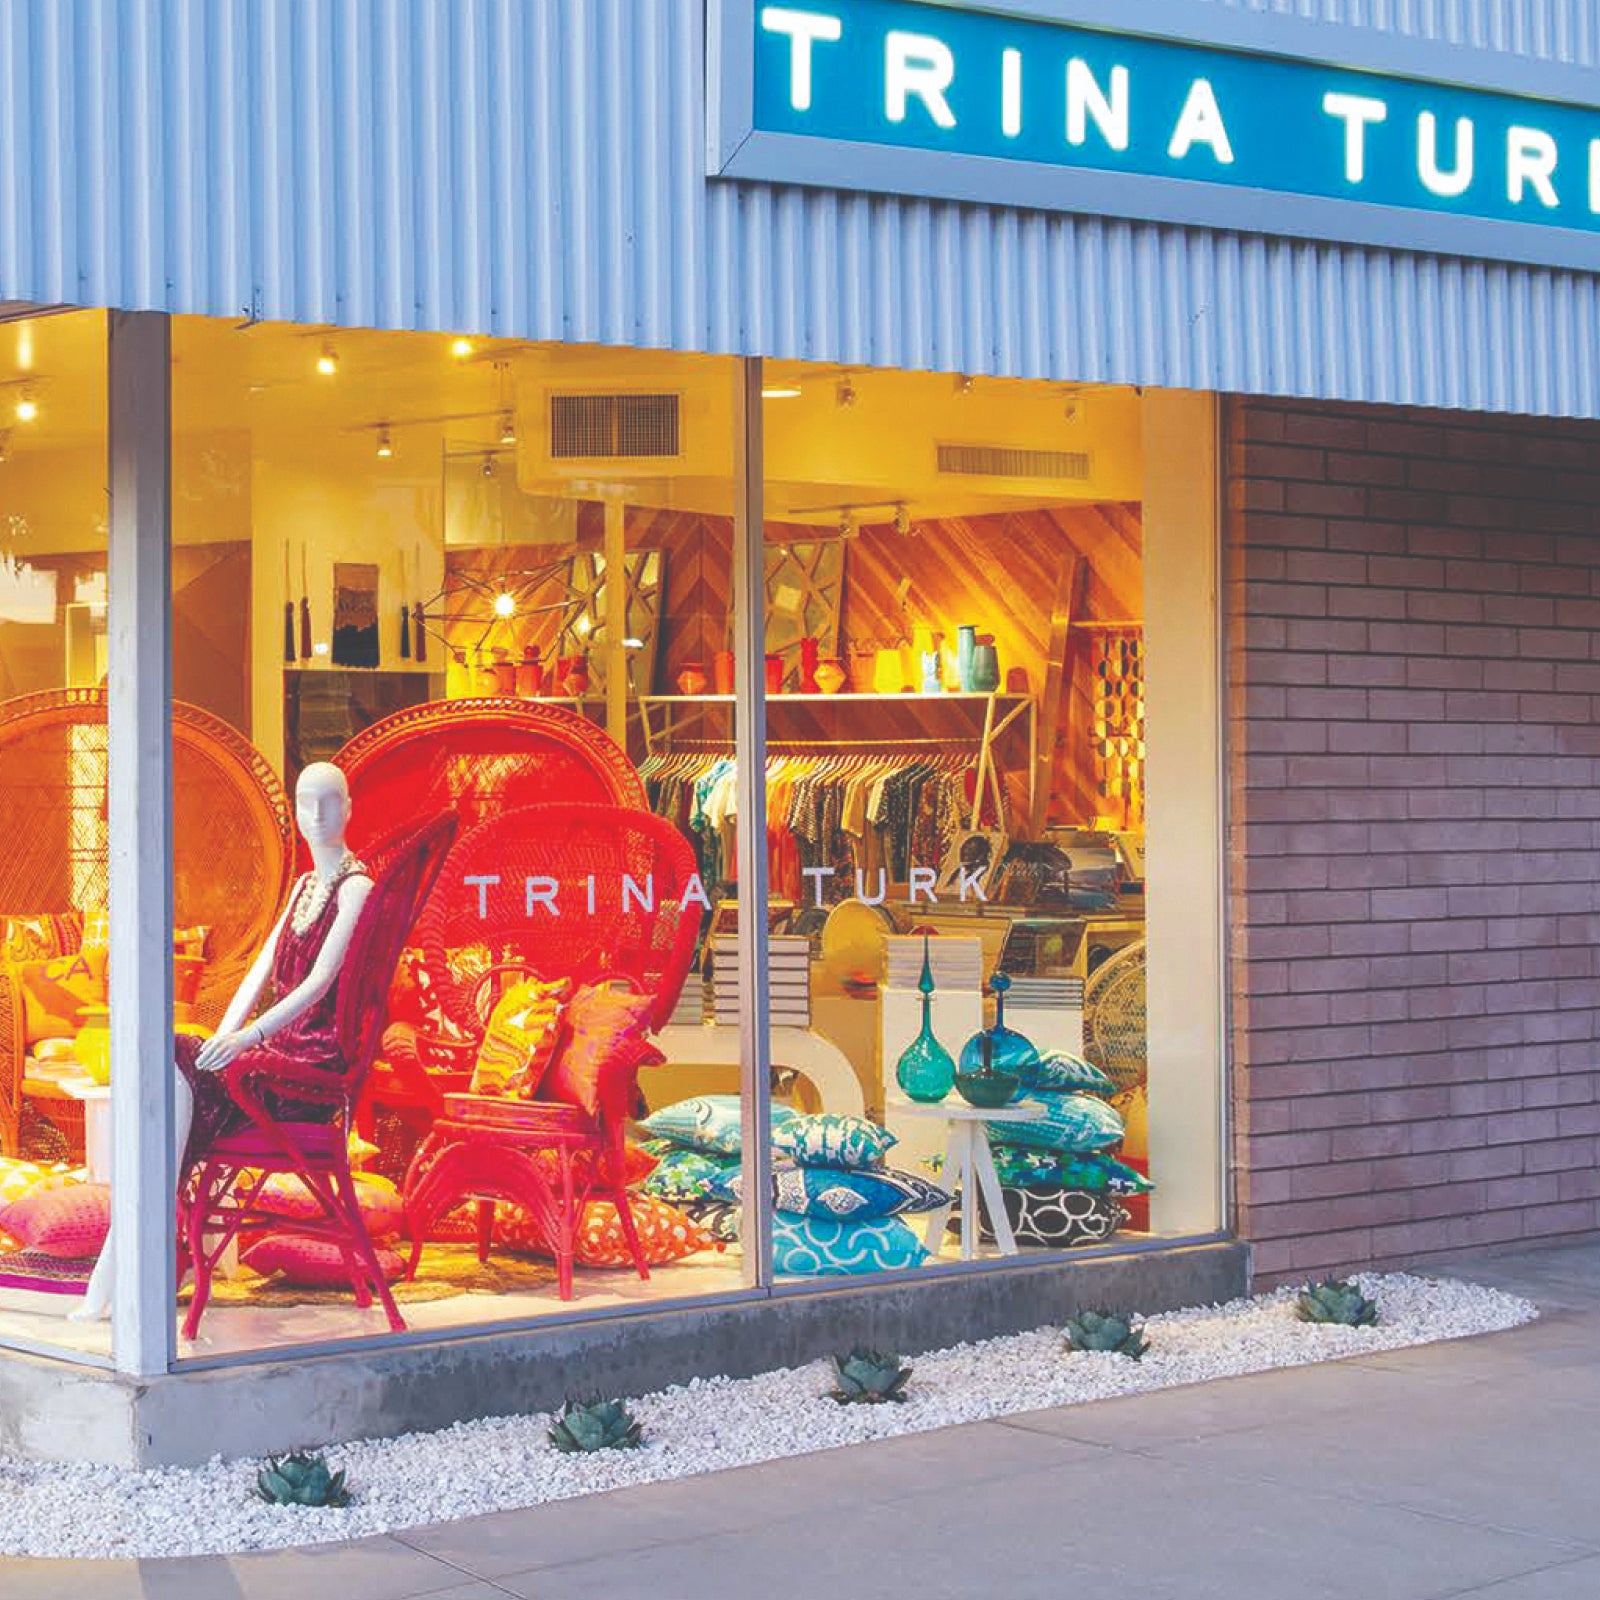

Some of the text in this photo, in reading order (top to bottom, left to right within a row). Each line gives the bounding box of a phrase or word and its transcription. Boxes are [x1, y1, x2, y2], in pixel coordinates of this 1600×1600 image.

[760, 4, 1600, 215] TRINA TUR
[464, 865, 989, 919] TRINA TURK
